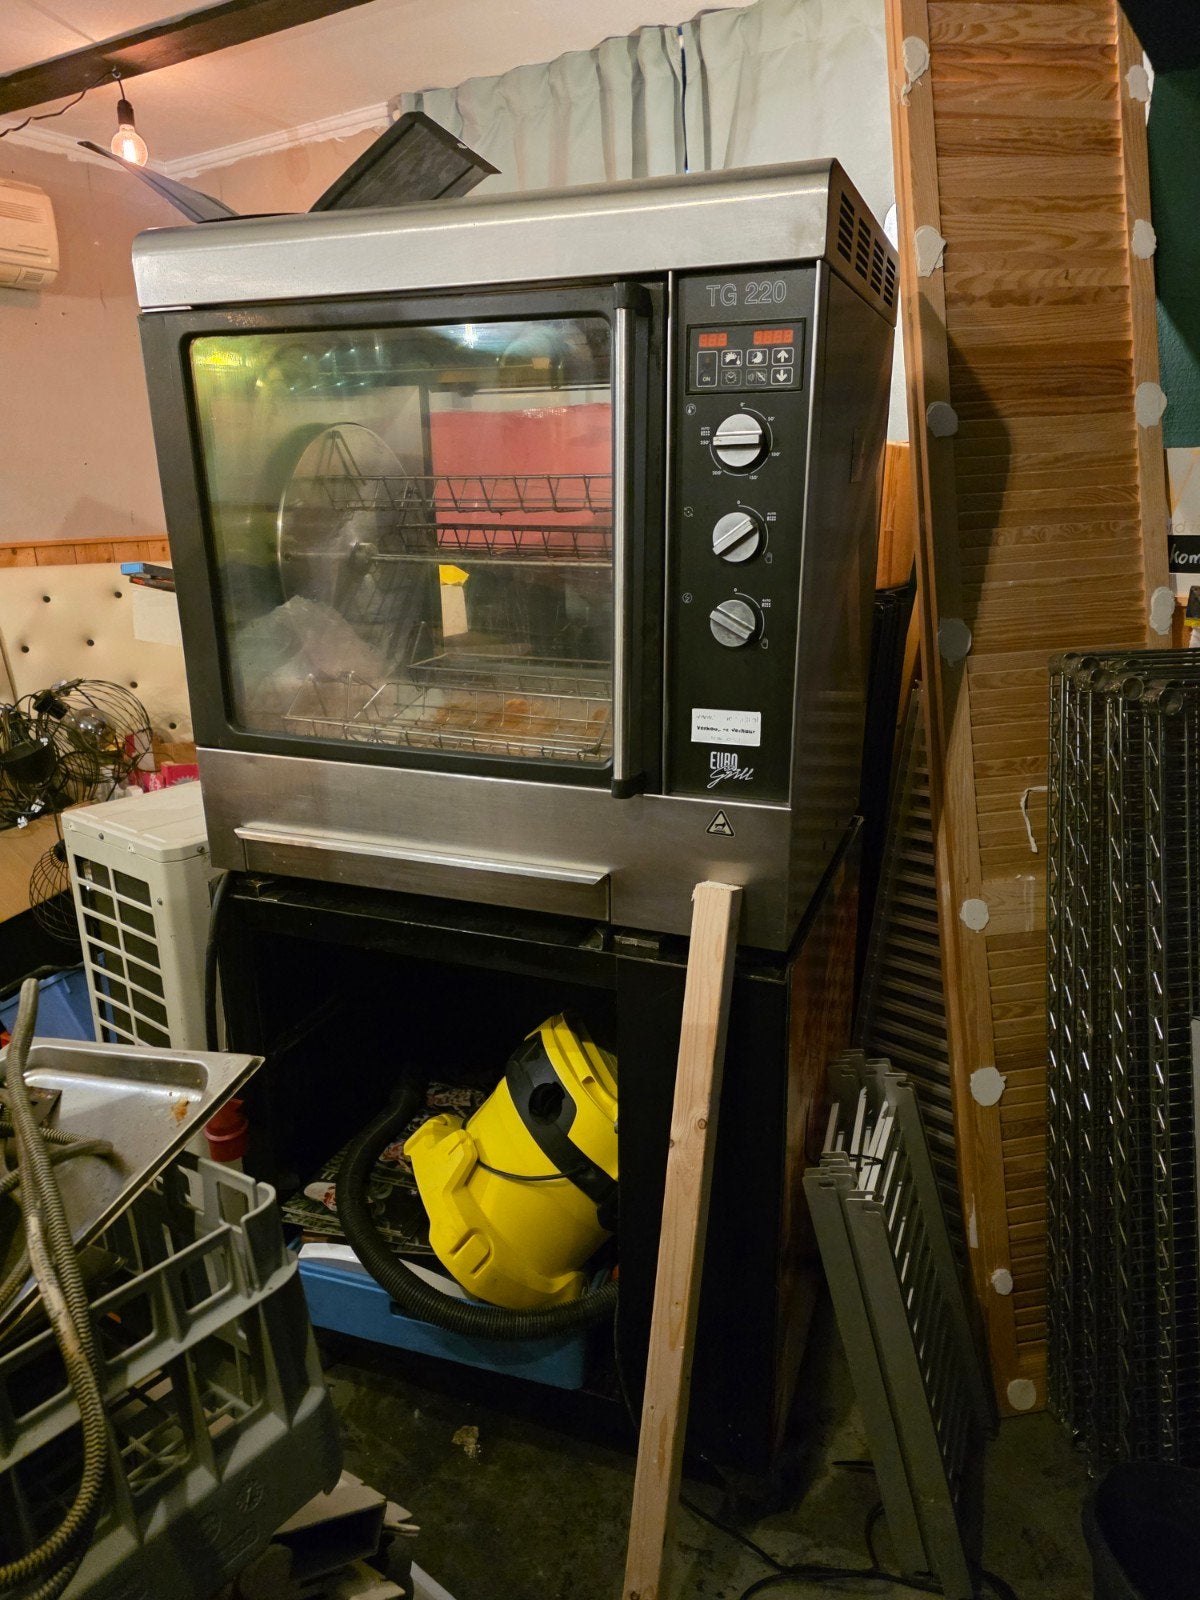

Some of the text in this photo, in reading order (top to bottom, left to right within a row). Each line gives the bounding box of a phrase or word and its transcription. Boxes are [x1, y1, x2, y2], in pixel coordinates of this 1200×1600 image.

[706, 280, 787, 307] TG 220
[709, 751, 738, 772] EURO
